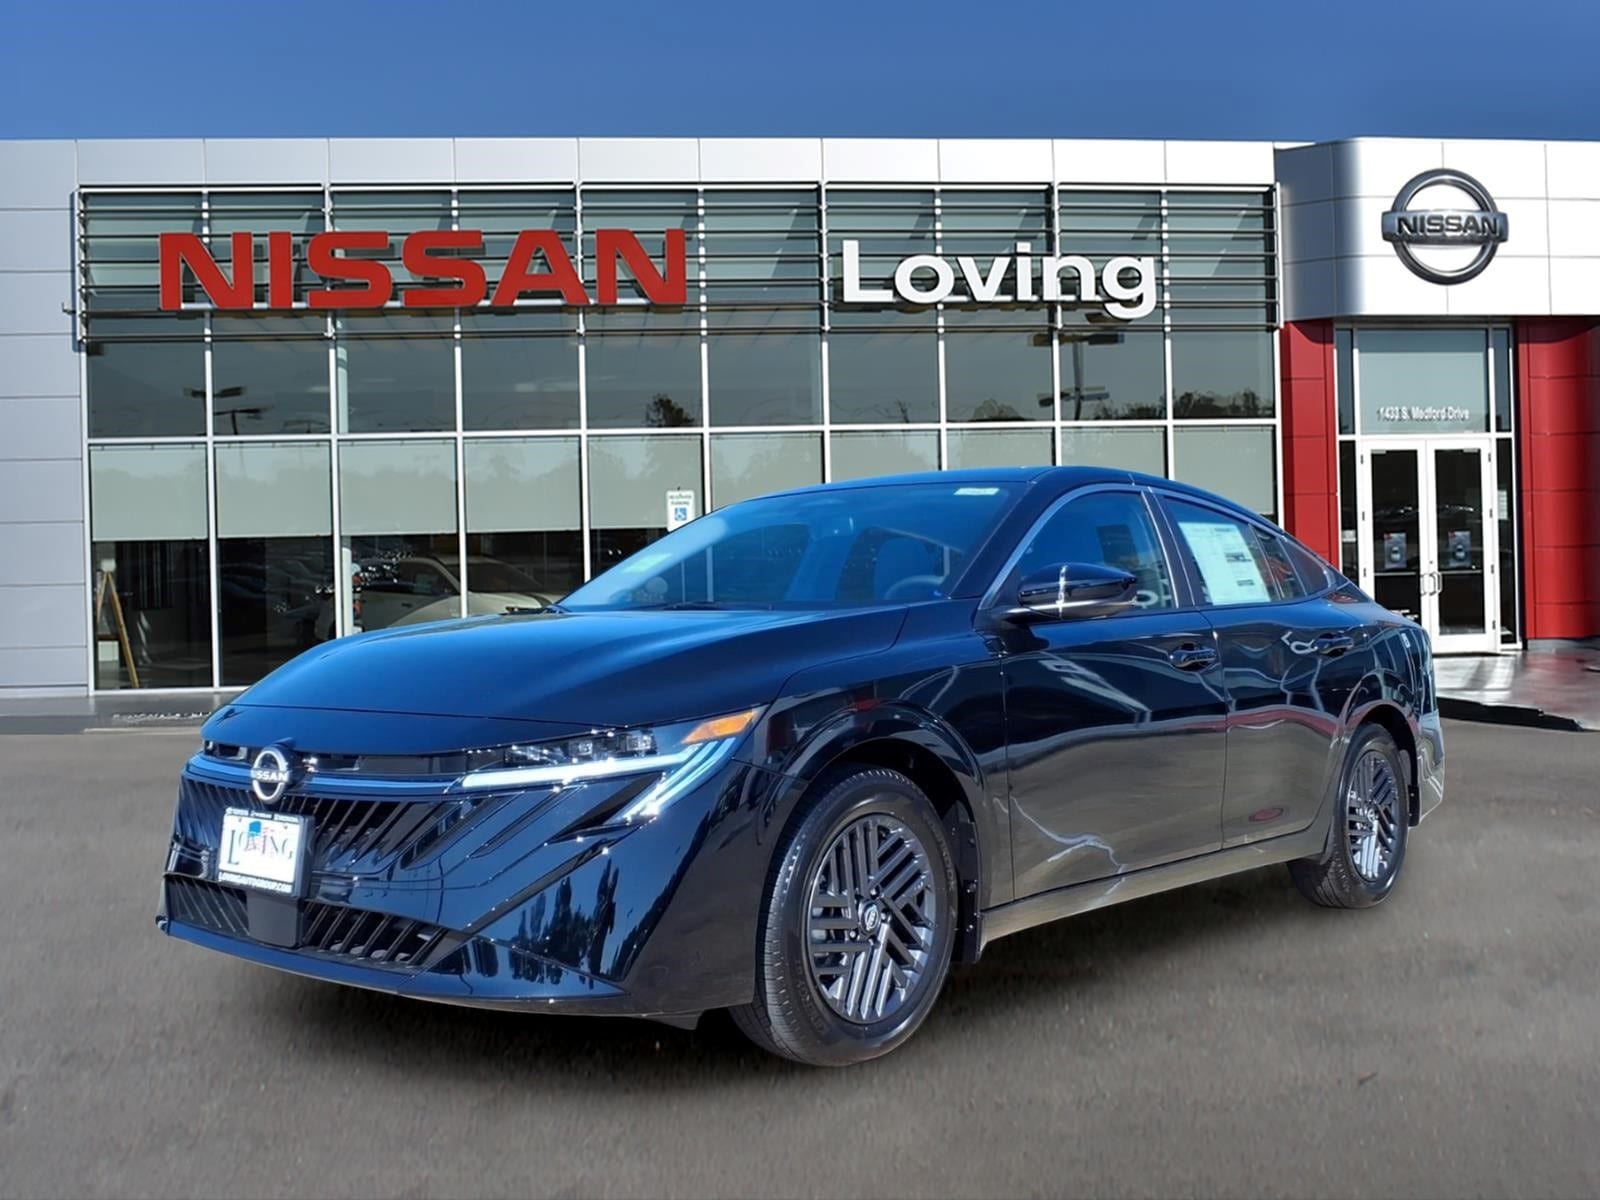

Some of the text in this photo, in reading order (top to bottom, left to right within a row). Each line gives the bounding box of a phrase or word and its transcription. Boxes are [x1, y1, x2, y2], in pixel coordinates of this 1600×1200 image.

[1396, 214, 1499, 235] NISSAN
[159, 228, 687, 310] NISSAN
[842, 239, 1157, 319] Loving
[1379, 405, 1399, 420] 1433
[1447, 405, 1470, 420] Drive
[251, 769, 290, 782] SSAN
[227, 828, 294, 866] LOVING
